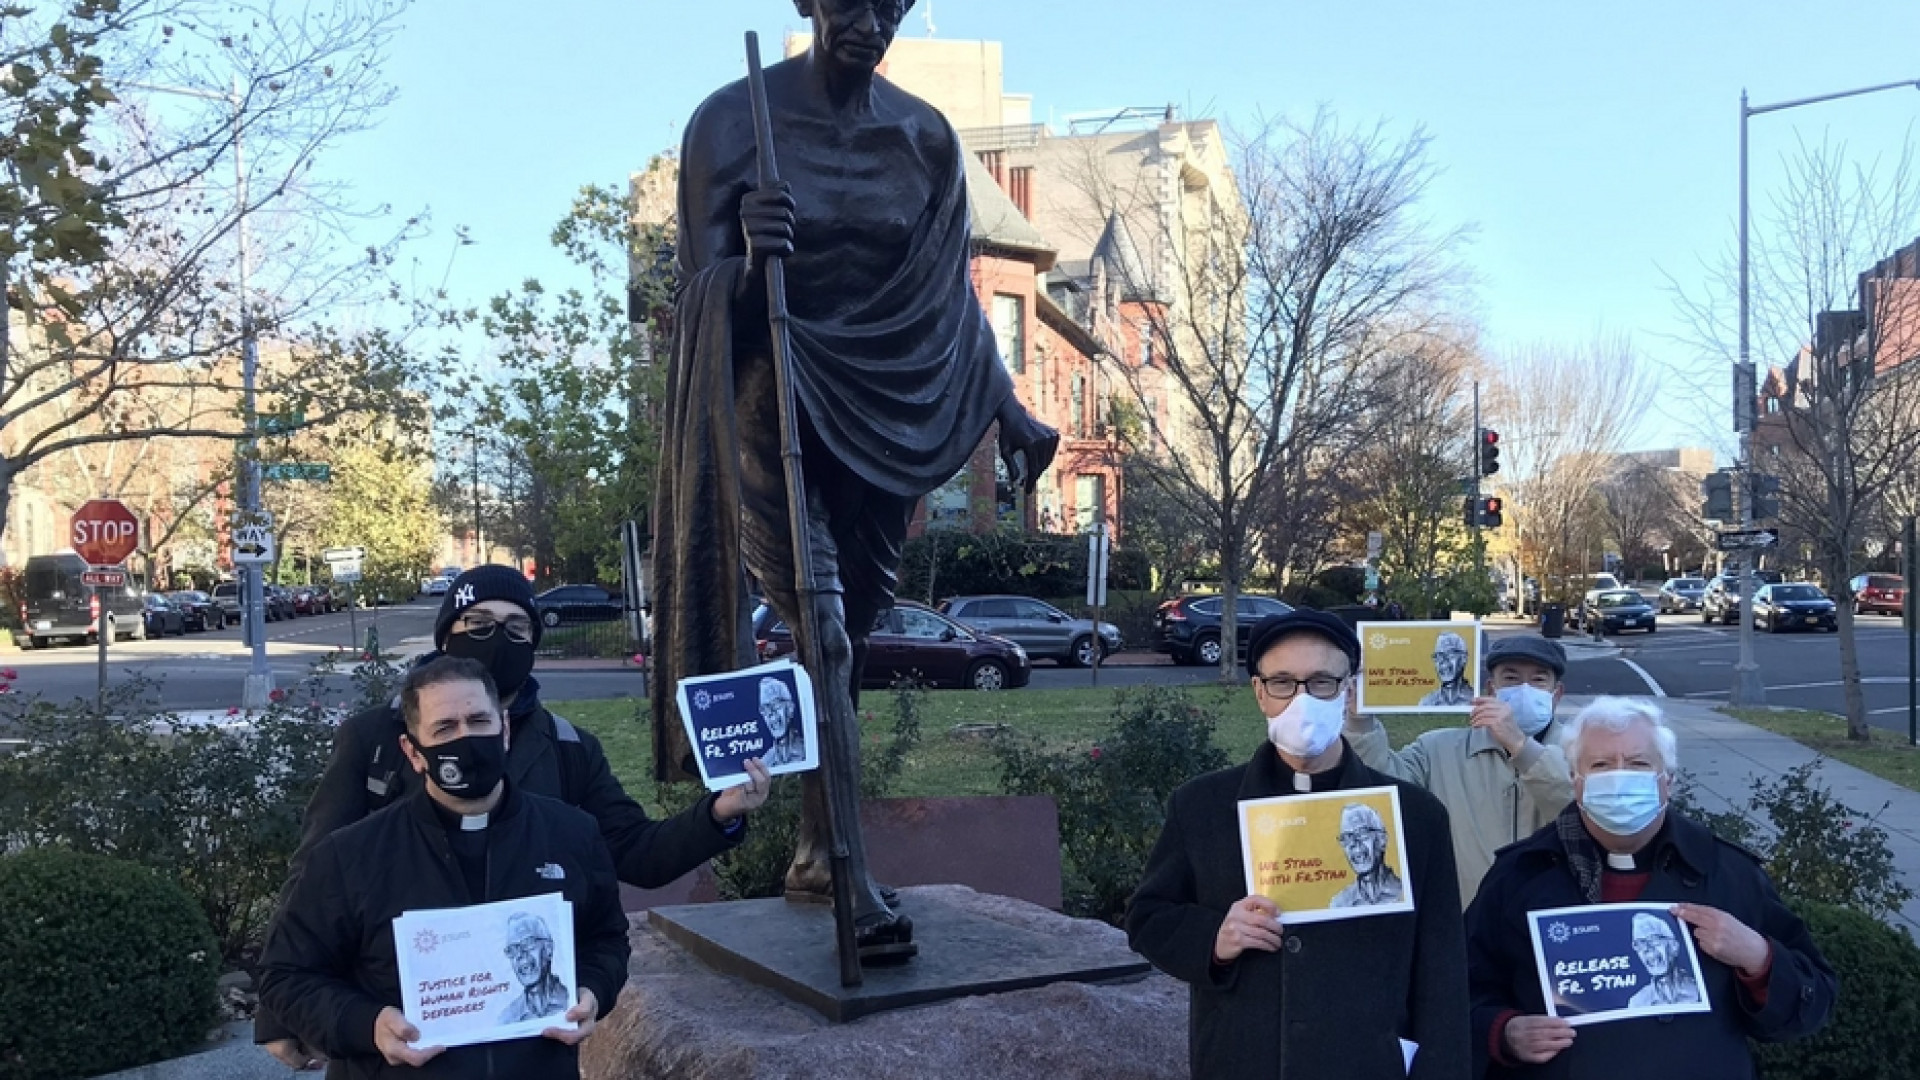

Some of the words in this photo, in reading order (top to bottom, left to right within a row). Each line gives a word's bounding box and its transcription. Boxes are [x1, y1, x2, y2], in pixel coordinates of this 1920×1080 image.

[73, 520, 135, 544] STOP
[701, 721, 758, 742] RELEASE
[728, 738, 764, 755] STAN
[1259, 861, 1279, 871] WE
[1284, 857, 1322, 870] STAND
[1259, 875, 1291, 885] WITH
[1555, 956, 1630, 976] RELEASE
[419, 976, 466, 992] JUSTICE
[470, 971, 492, 983] FOR
[1558, 978, 1584, 996] FR.
[1590, 974, 1637, 991] STAN
[421, 991, 464, 1006] HUMAN
[468, 981, 510, 998] RIGHTS
[422, 1000, 486, 1021] DEFENDERS
